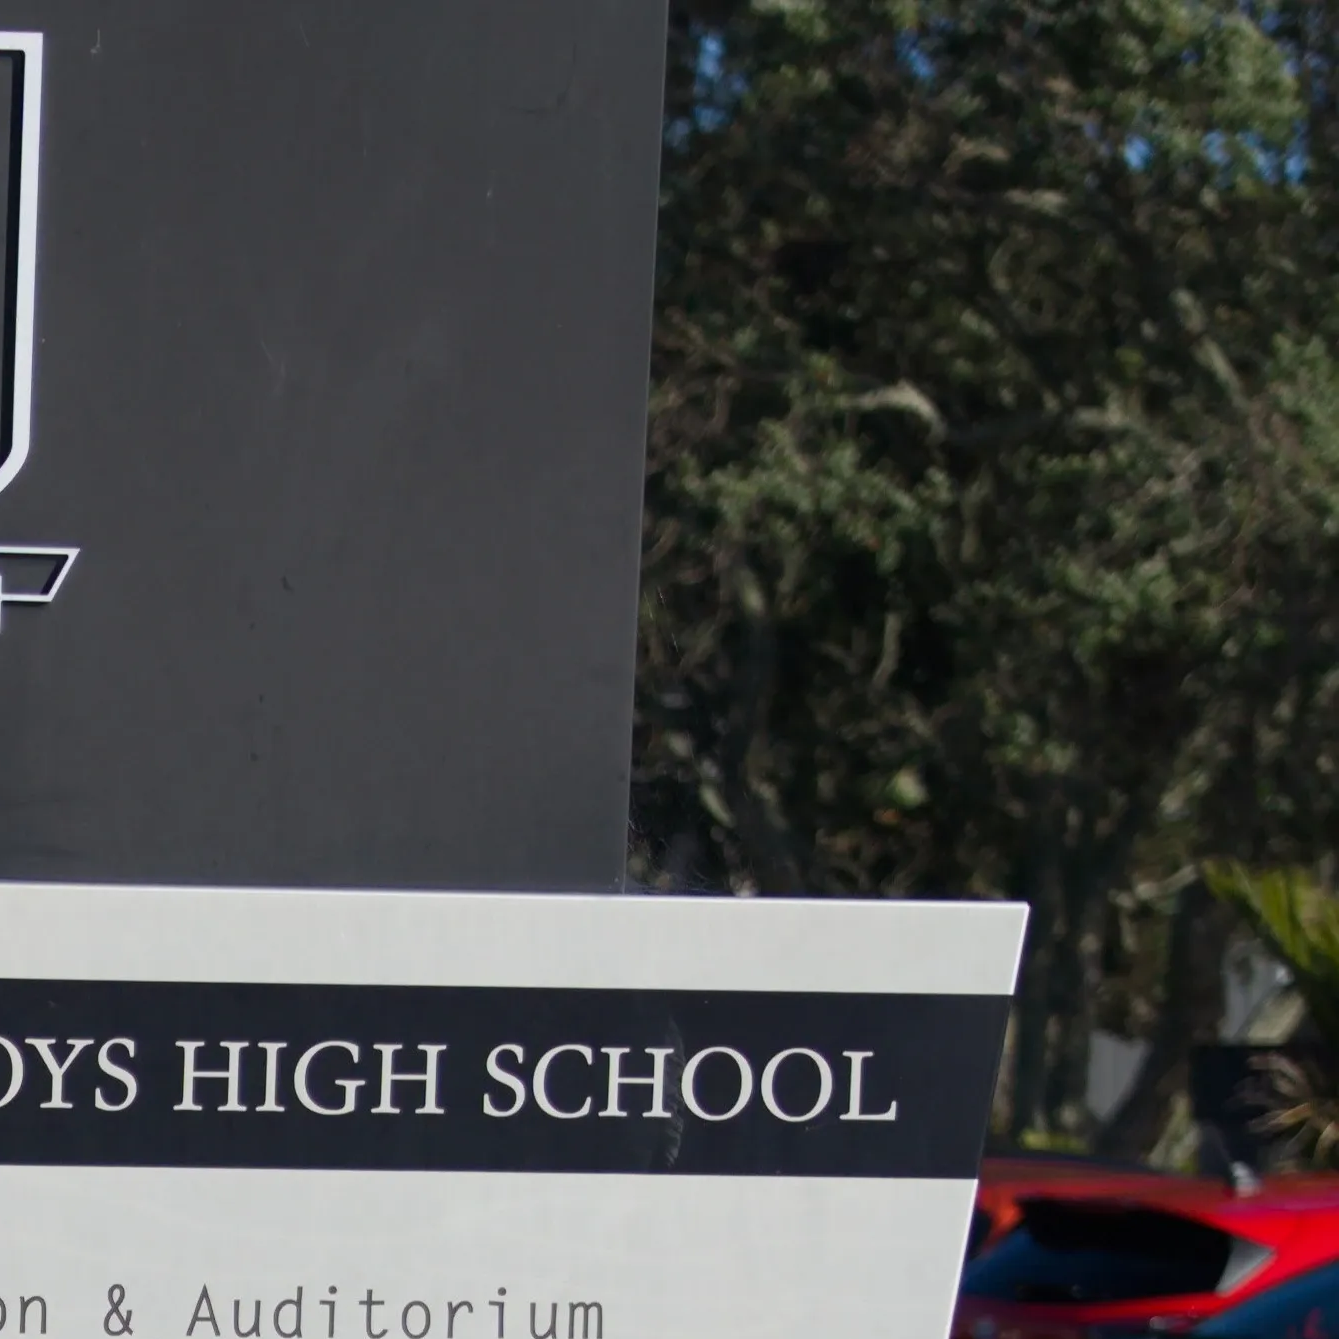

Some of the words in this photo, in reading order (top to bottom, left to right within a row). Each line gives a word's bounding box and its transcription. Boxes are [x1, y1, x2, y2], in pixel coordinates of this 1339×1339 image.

[172, 1040, 447, 1116] HIGH
[484, 1044, 896, 1122] SCHOOL
[102, 1283, 134, 1337] &
